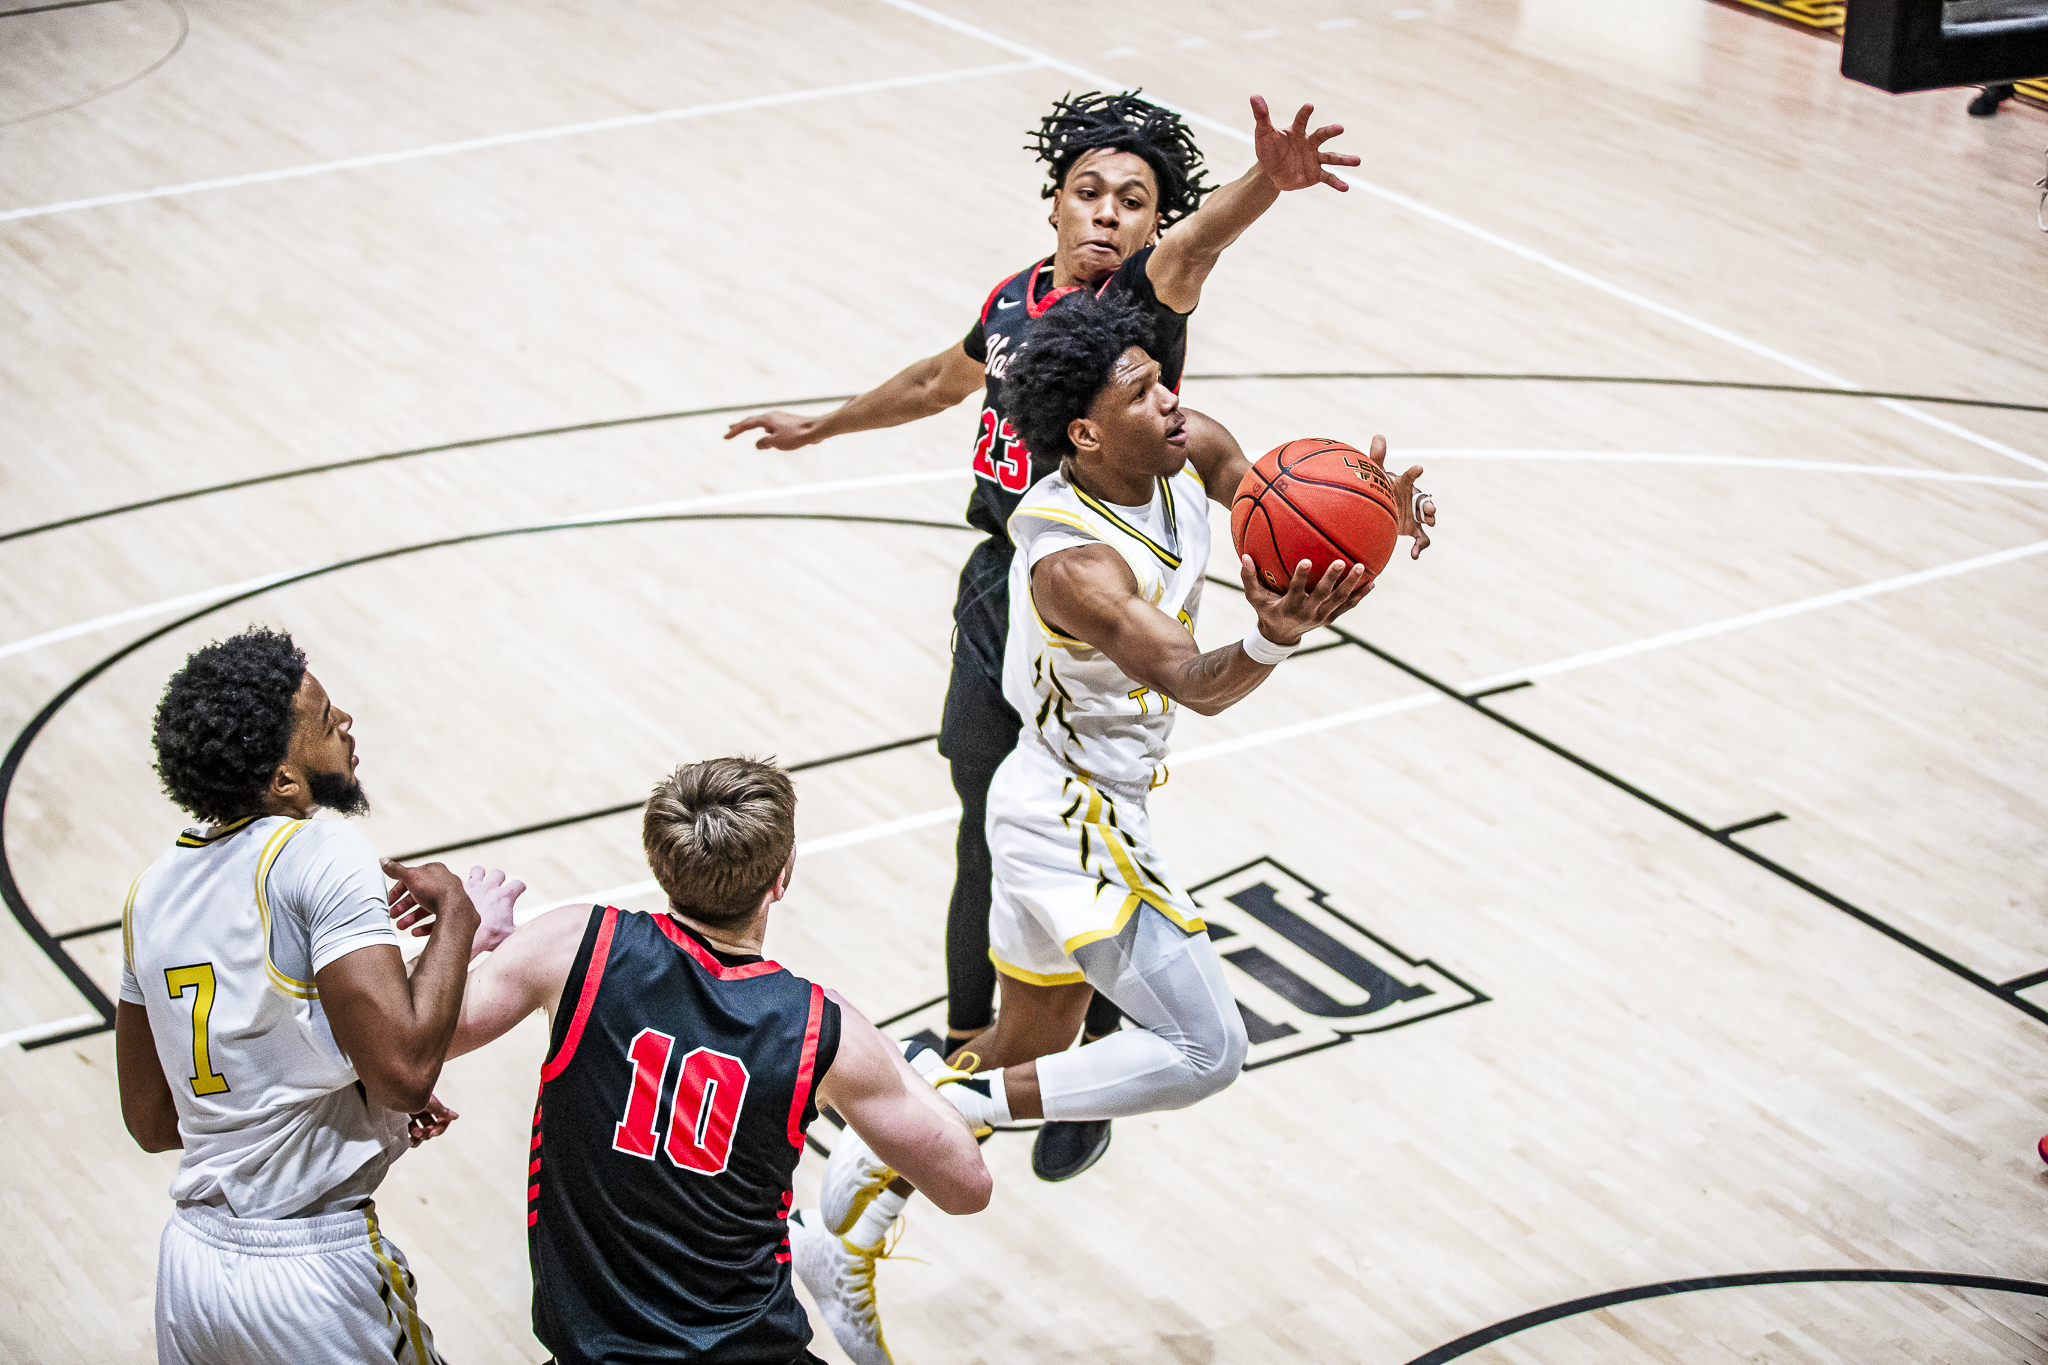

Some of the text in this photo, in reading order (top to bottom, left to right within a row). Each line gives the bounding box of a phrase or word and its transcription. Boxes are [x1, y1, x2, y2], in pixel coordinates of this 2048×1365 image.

[973, 406, 1032, 494] 23
[163, 961, 232, 1098] 7
[612, 1026, 750, 1176] 10
